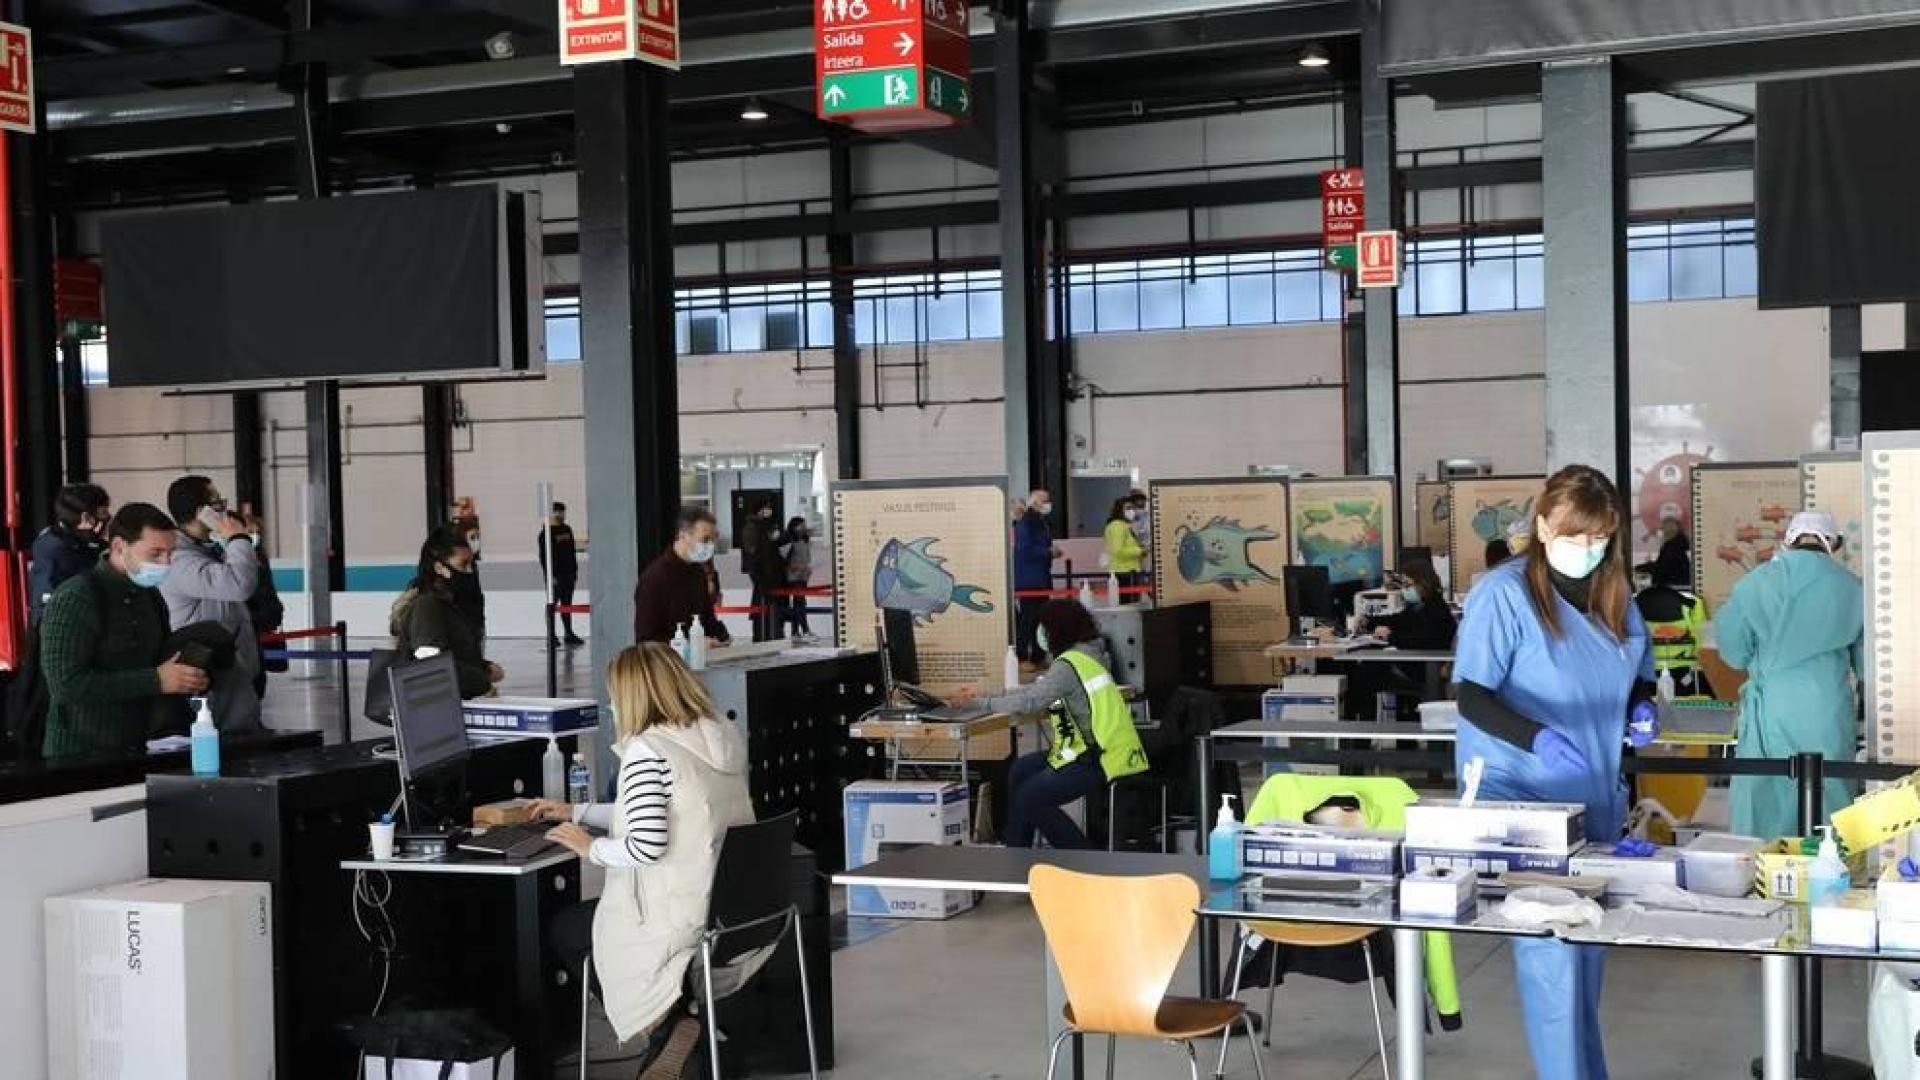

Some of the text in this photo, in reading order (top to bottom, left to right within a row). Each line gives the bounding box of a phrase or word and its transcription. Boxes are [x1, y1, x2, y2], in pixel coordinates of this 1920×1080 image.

[570, 30, 624, 48] EXTINTOR
[823, 32, 864, 49] Salida
[127, 910, 142, 970] LUCAS
